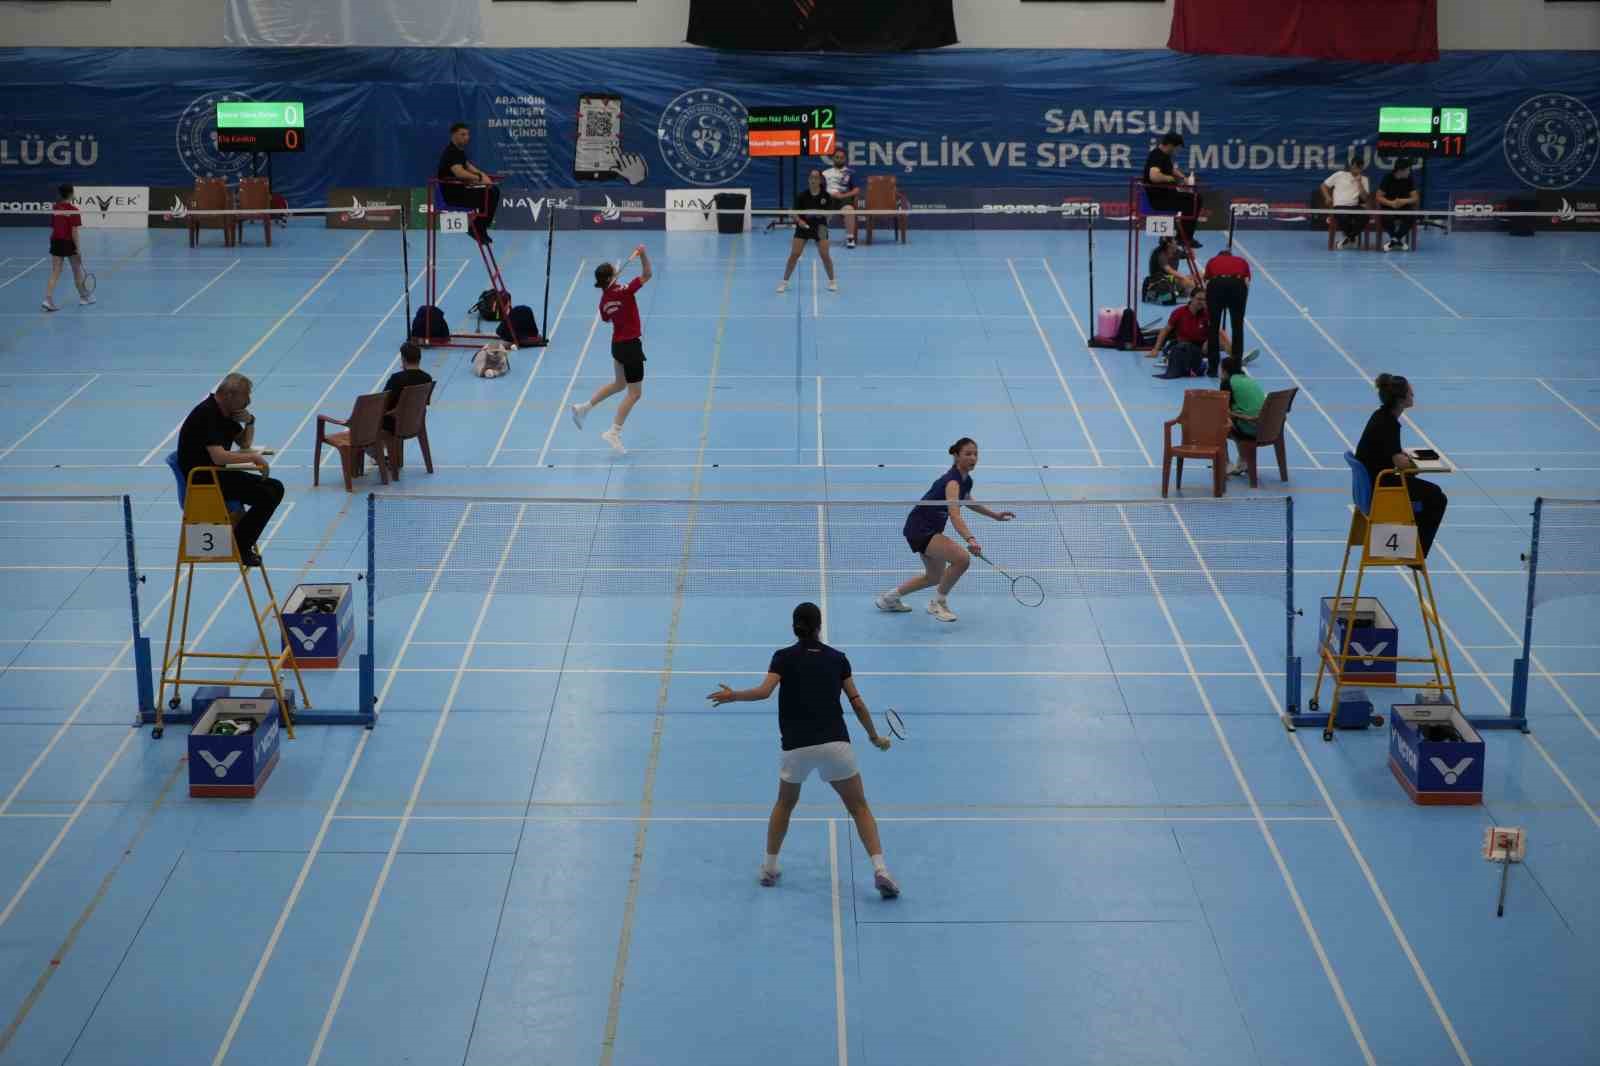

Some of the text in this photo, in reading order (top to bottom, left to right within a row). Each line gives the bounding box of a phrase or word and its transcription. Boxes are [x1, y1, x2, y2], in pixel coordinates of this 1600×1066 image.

[285, 106, 297, 125] 0
[801, 113, 808, 123] 0
[811, 108, 834, 129] 12
[1044, 109, 1200, 135] SAMSUN
[1444, 111, 1465, 131] 13
[285, 129, 298, 149] 0
[811, 133, 834, 153] 17
[1442, 136, 1461, 155] 11
[981, 142, 1028, 167] VE
[1037, 142, 1132, 169] SPOR
[447, 218, 463, 231] 16
[1151, 221, 1168, 233] 15
[201, 533, 214, 551] 3
[1385, 533, 1400, 551] 4
